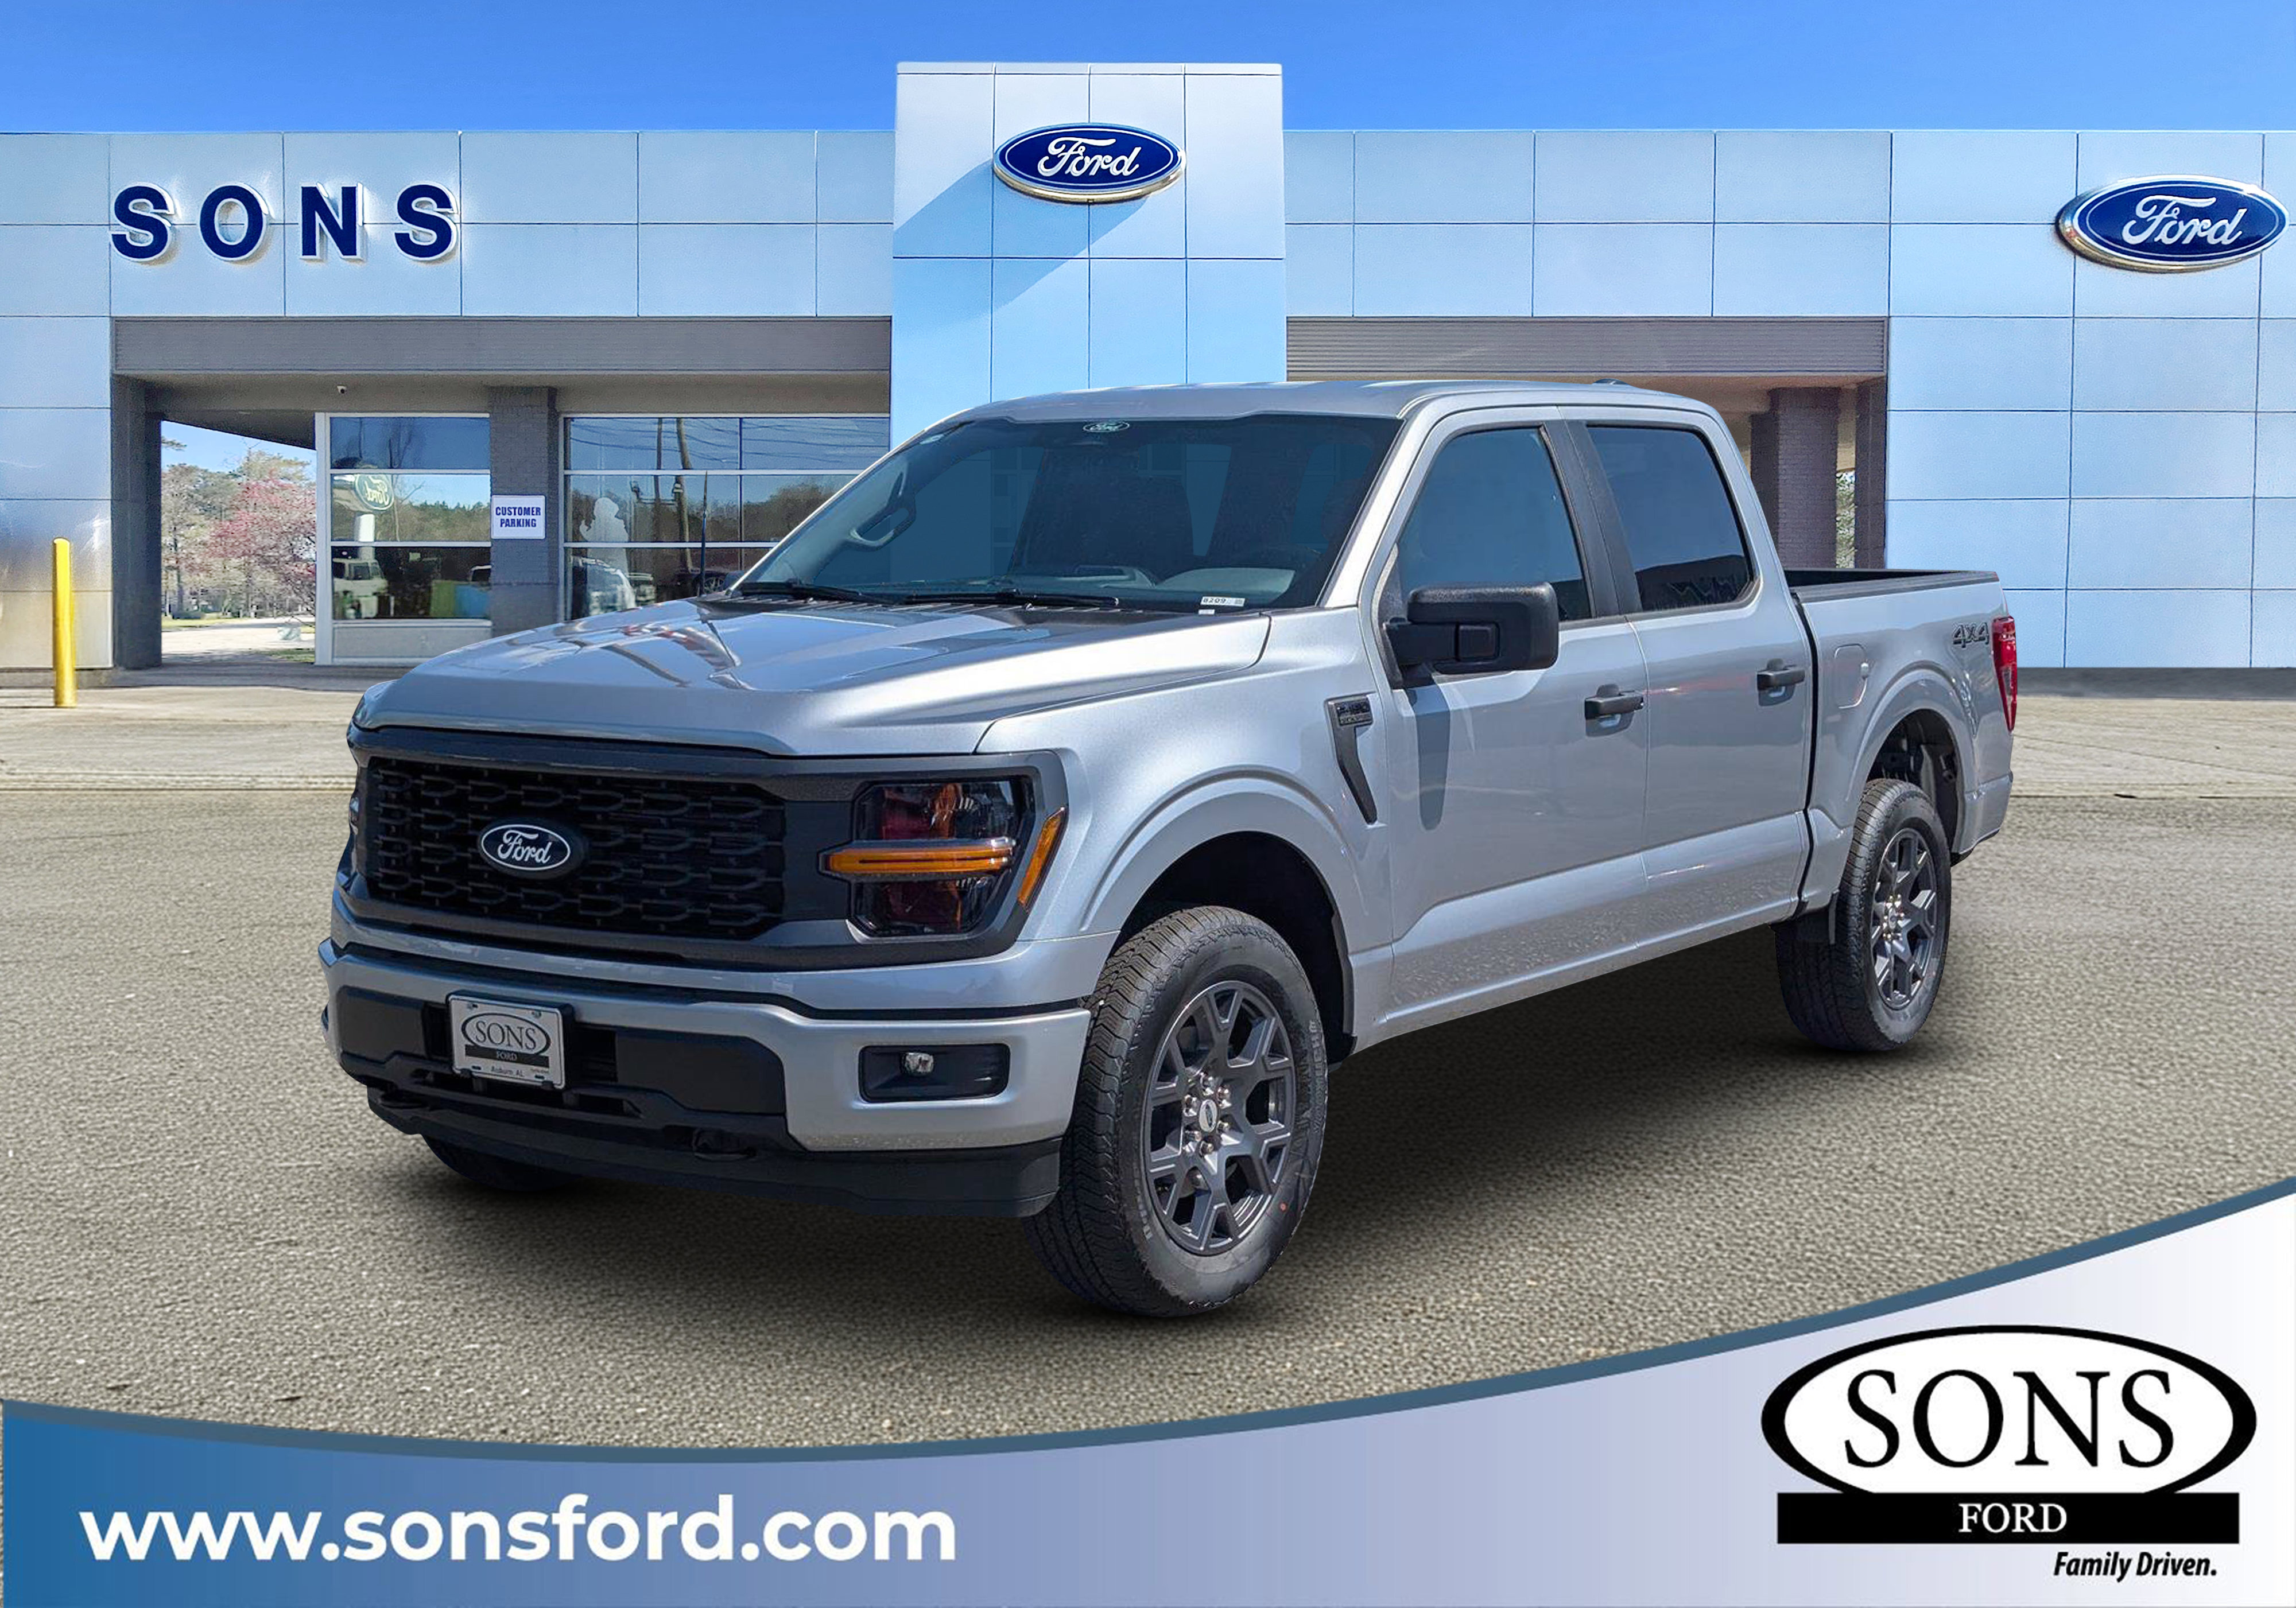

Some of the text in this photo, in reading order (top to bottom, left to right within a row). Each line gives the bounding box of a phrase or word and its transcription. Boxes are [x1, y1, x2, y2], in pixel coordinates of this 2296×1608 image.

[1037, 137, 1142, 177] Ford
[111, 182, 458, 261] SONS
[2122, 195, 2247, 245] Ford
[495, 506, 541, 516] CUSTOMER
[500, 518, 537, 527] PARKING
[497, 829, 552, 864] Ford
[475, 1020, 537, 1050] SONS
[496, 1050, 517, 1061] FORD
